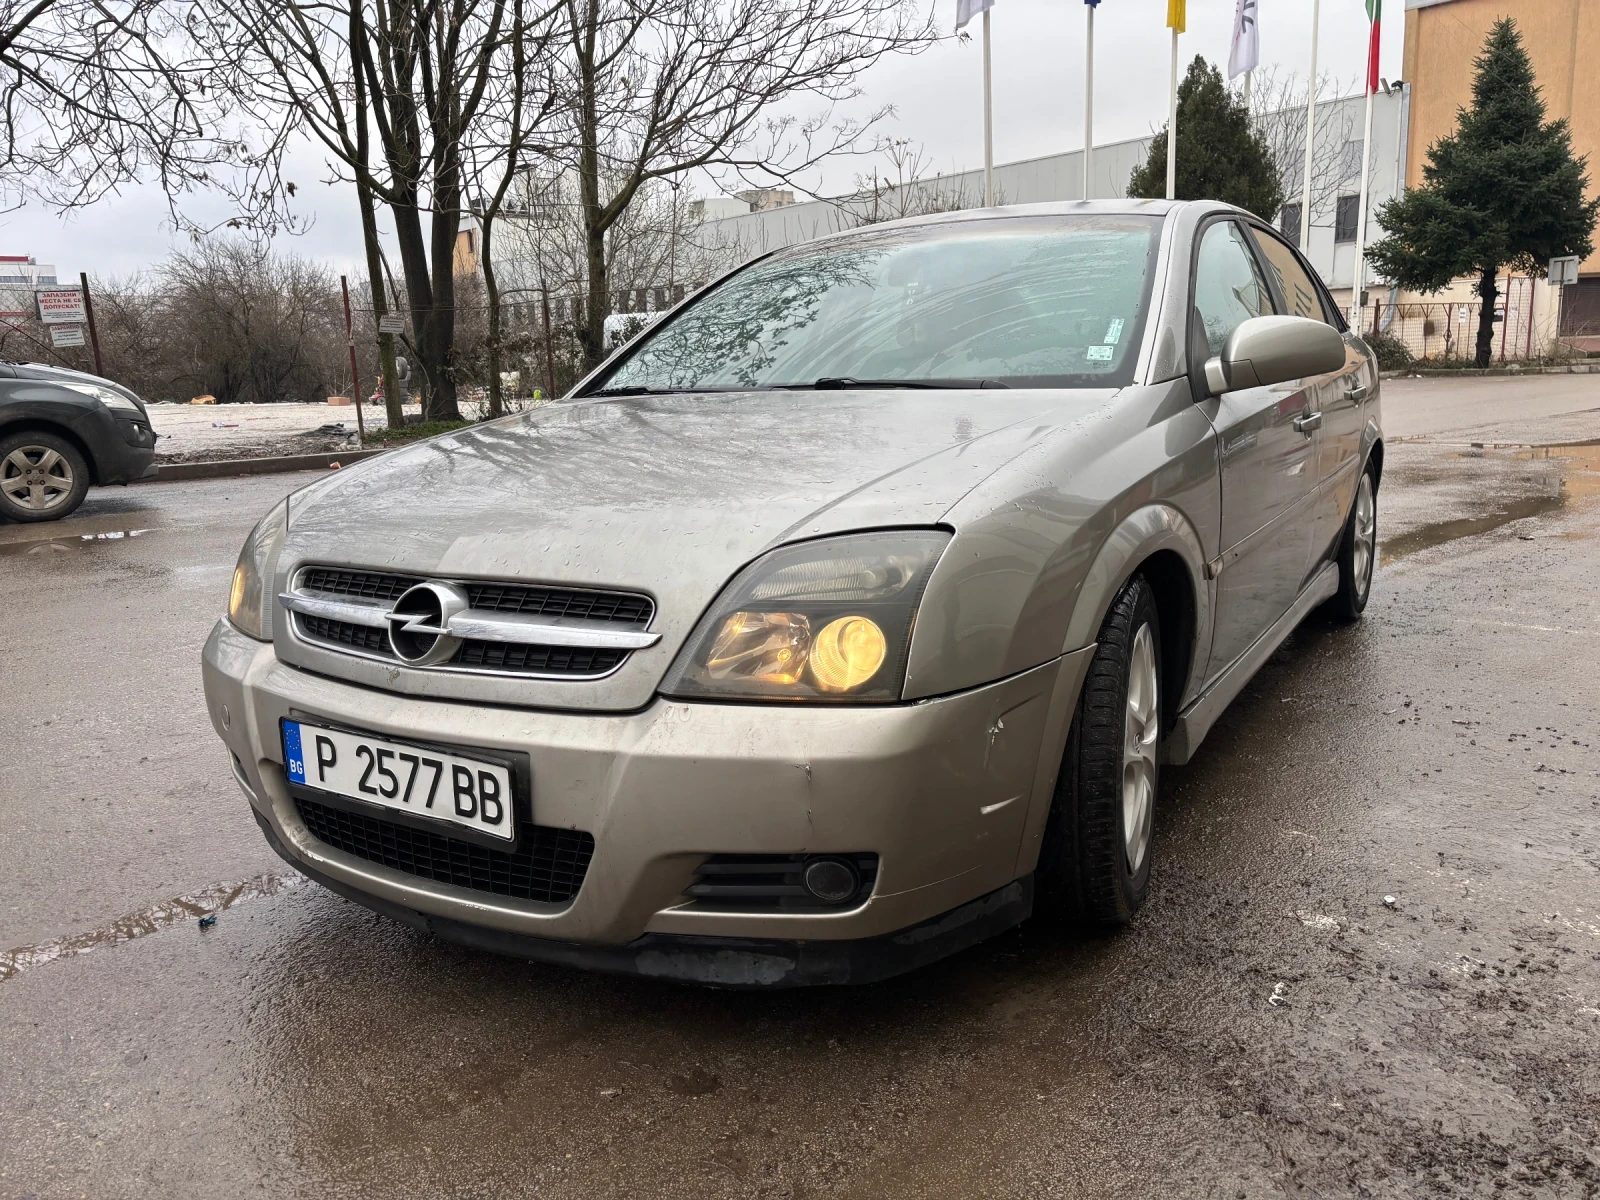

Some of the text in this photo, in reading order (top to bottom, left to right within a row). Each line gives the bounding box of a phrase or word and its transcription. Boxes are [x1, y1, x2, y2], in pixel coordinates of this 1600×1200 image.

[289, 759, 304, 775] BG
[315, 734, 503, 826] P 2577 BB
